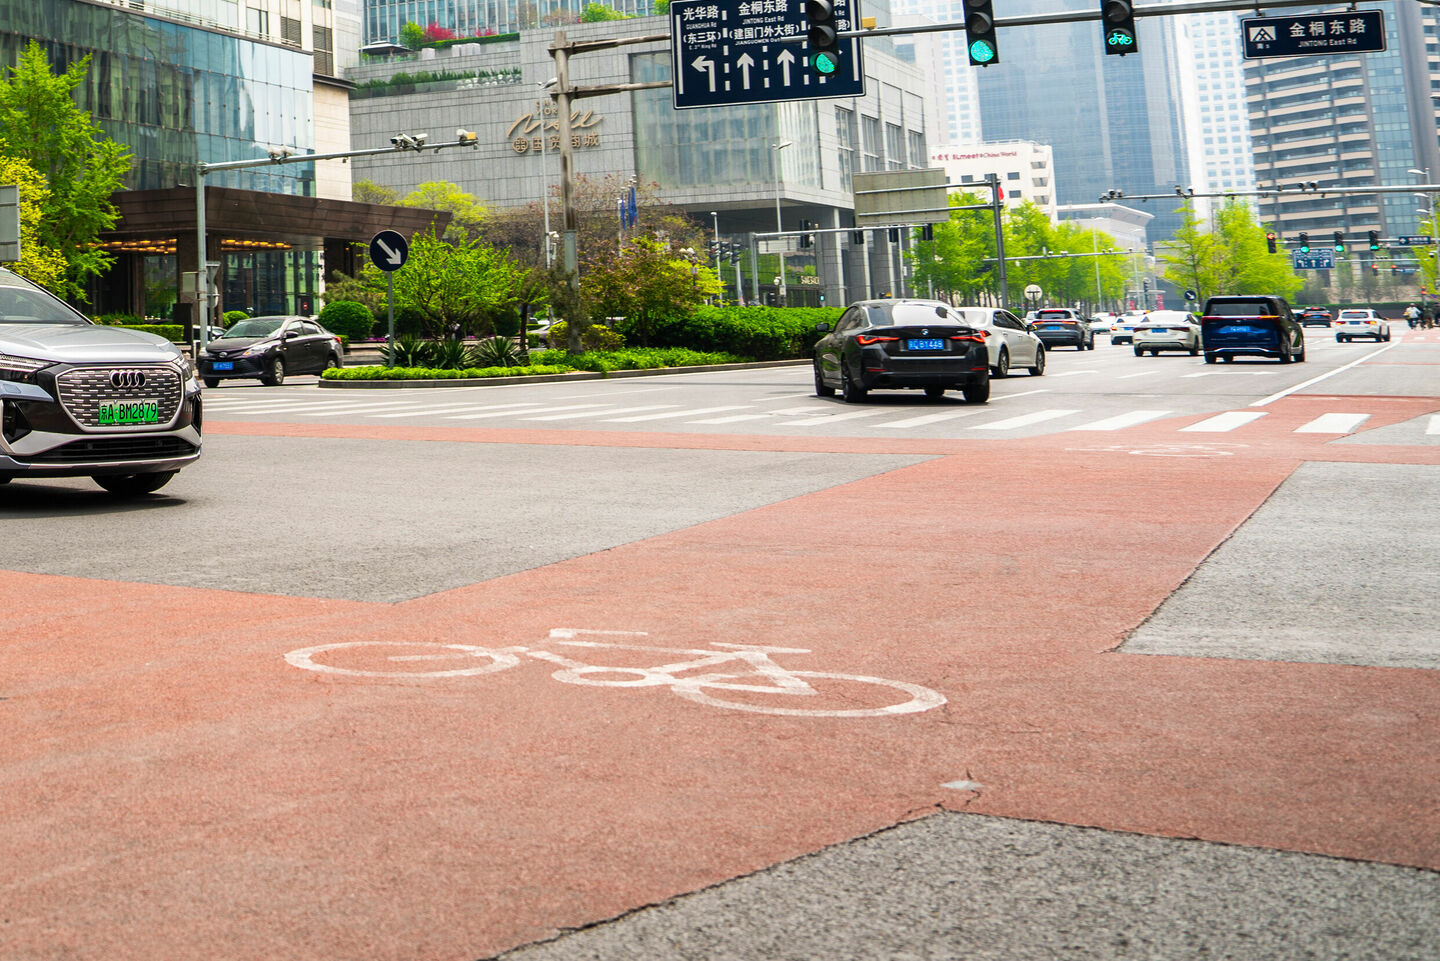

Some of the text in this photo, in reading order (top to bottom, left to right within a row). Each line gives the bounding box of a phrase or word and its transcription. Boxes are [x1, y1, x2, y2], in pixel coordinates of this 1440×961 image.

[683, 5, 719, 21] 光华路
[742, 14, 785, 25] JINTONG East Rd
[1288, 18, 1366, 38] 金桐东路
[1298, 37, 1357, 48] JINTONG East Rd
